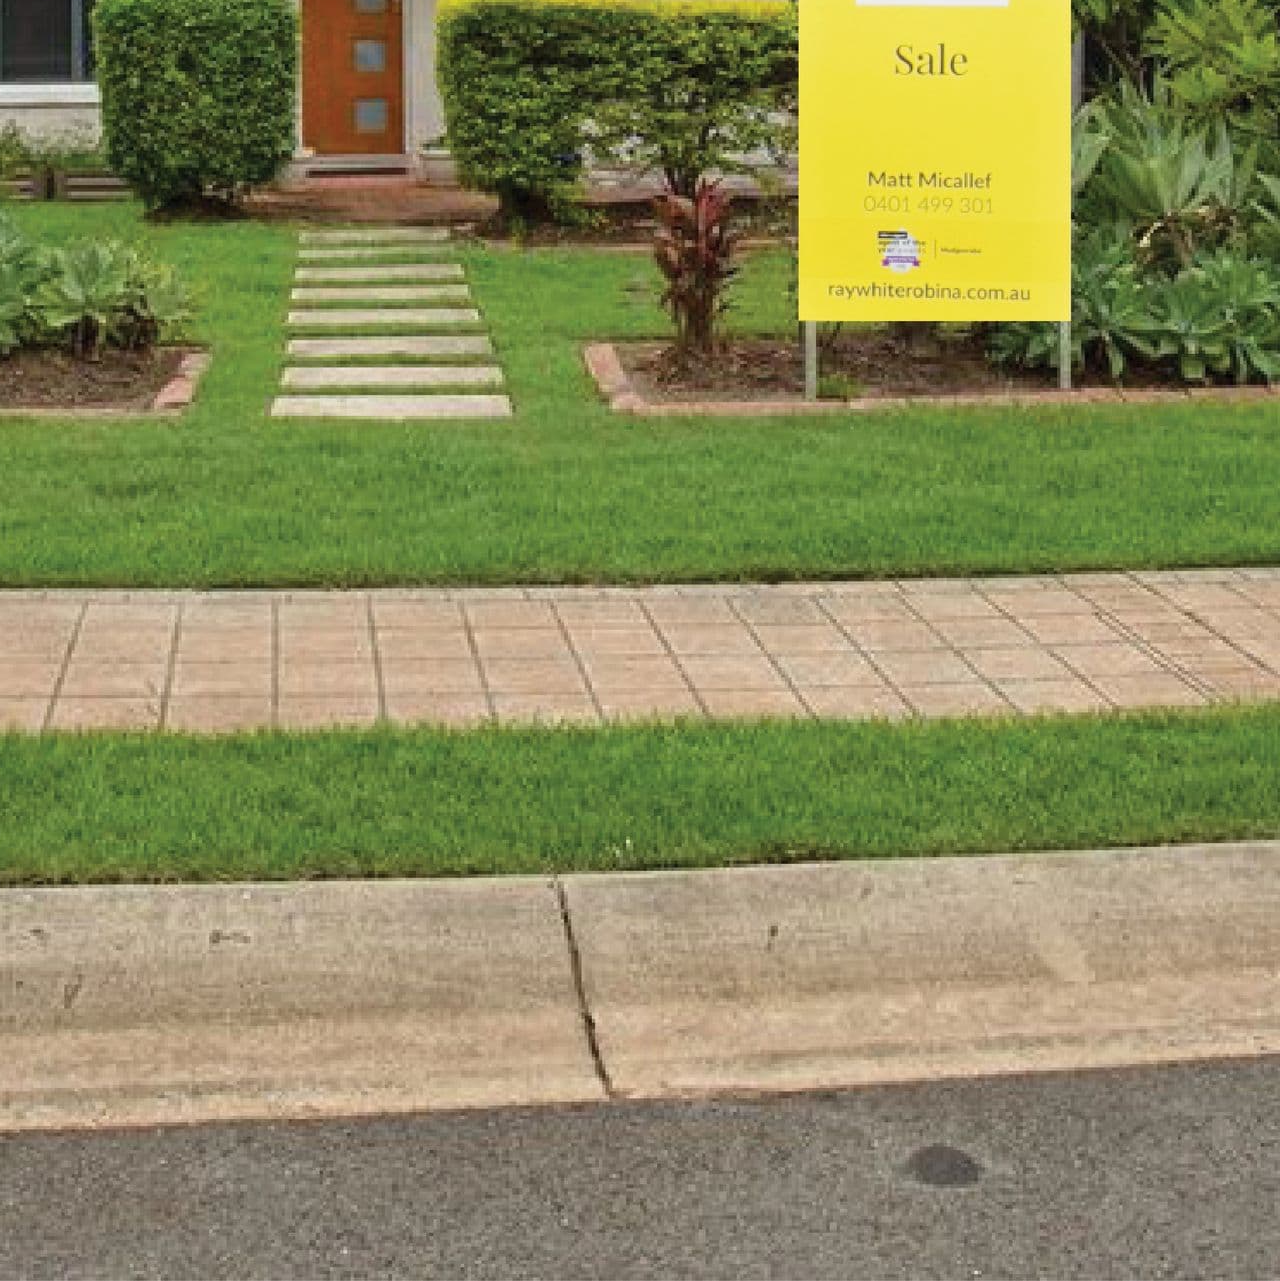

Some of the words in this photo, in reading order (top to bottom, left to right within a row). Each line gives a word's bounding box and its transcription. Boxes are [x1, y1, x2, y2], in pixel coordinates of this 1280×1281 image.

[895, 43, 968, 76] Sale
[868, 171, 912, 188] Matt
[918, 172, 992, 188] Micallef
[863, 195, 910, 212] 0401
[918, 197, 953, 213] 499
[960, 197, 993, 214] 301
[828, 282, 1030, 301] raywhiterobina.com.au
